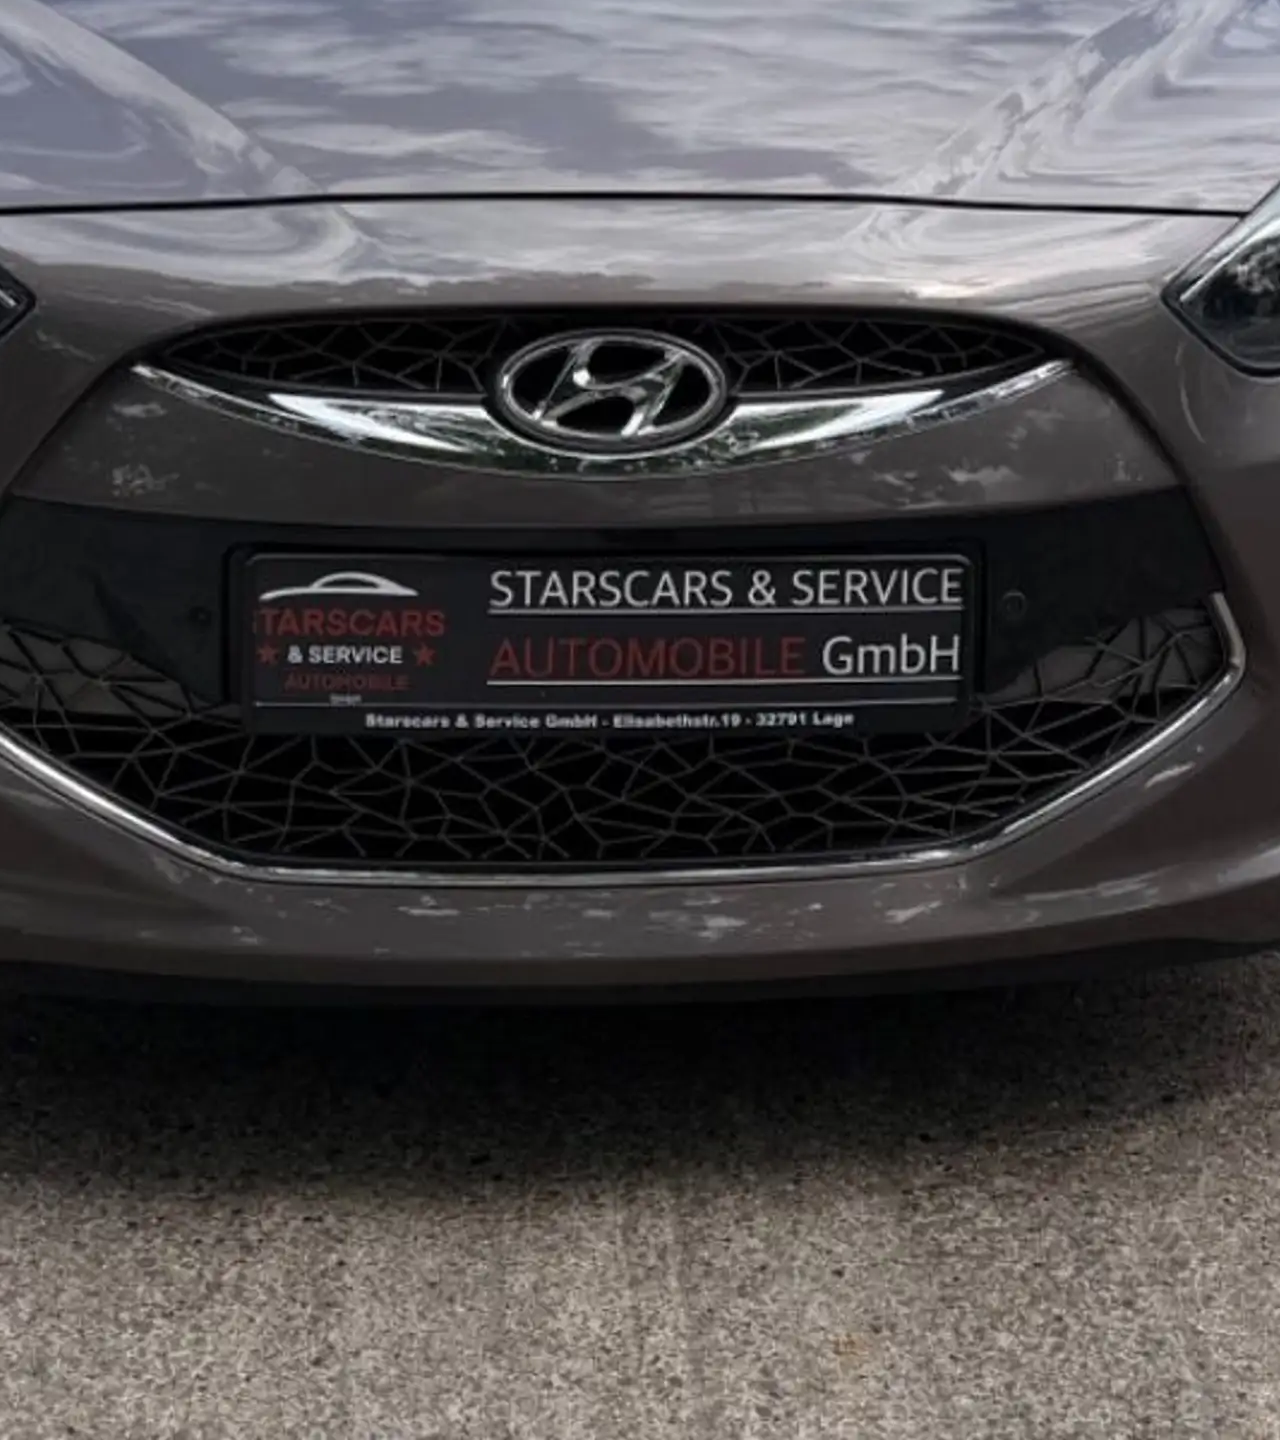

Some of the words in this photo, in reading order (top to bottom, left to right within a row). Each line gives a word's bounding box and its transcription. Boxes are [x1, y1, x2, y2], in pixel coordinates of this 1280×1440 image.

[489, 569, 733, 607] STARSCARS
[748, 569, 777, 607] &
[791, 567, 965, 606] SERVICE
[287, 644, 304, 663] &
[308, 644, 403, 663] SERVICE
[489, 635, 806, 677] AUTOMOBILE
[822, 633, 960, 675] GmbH
[365, 712, 450, 728] Starscars
[454, 713, 469, 728] &
[474, 712, 540, 728] Service
[545, 712, 597, 728] GmbH
